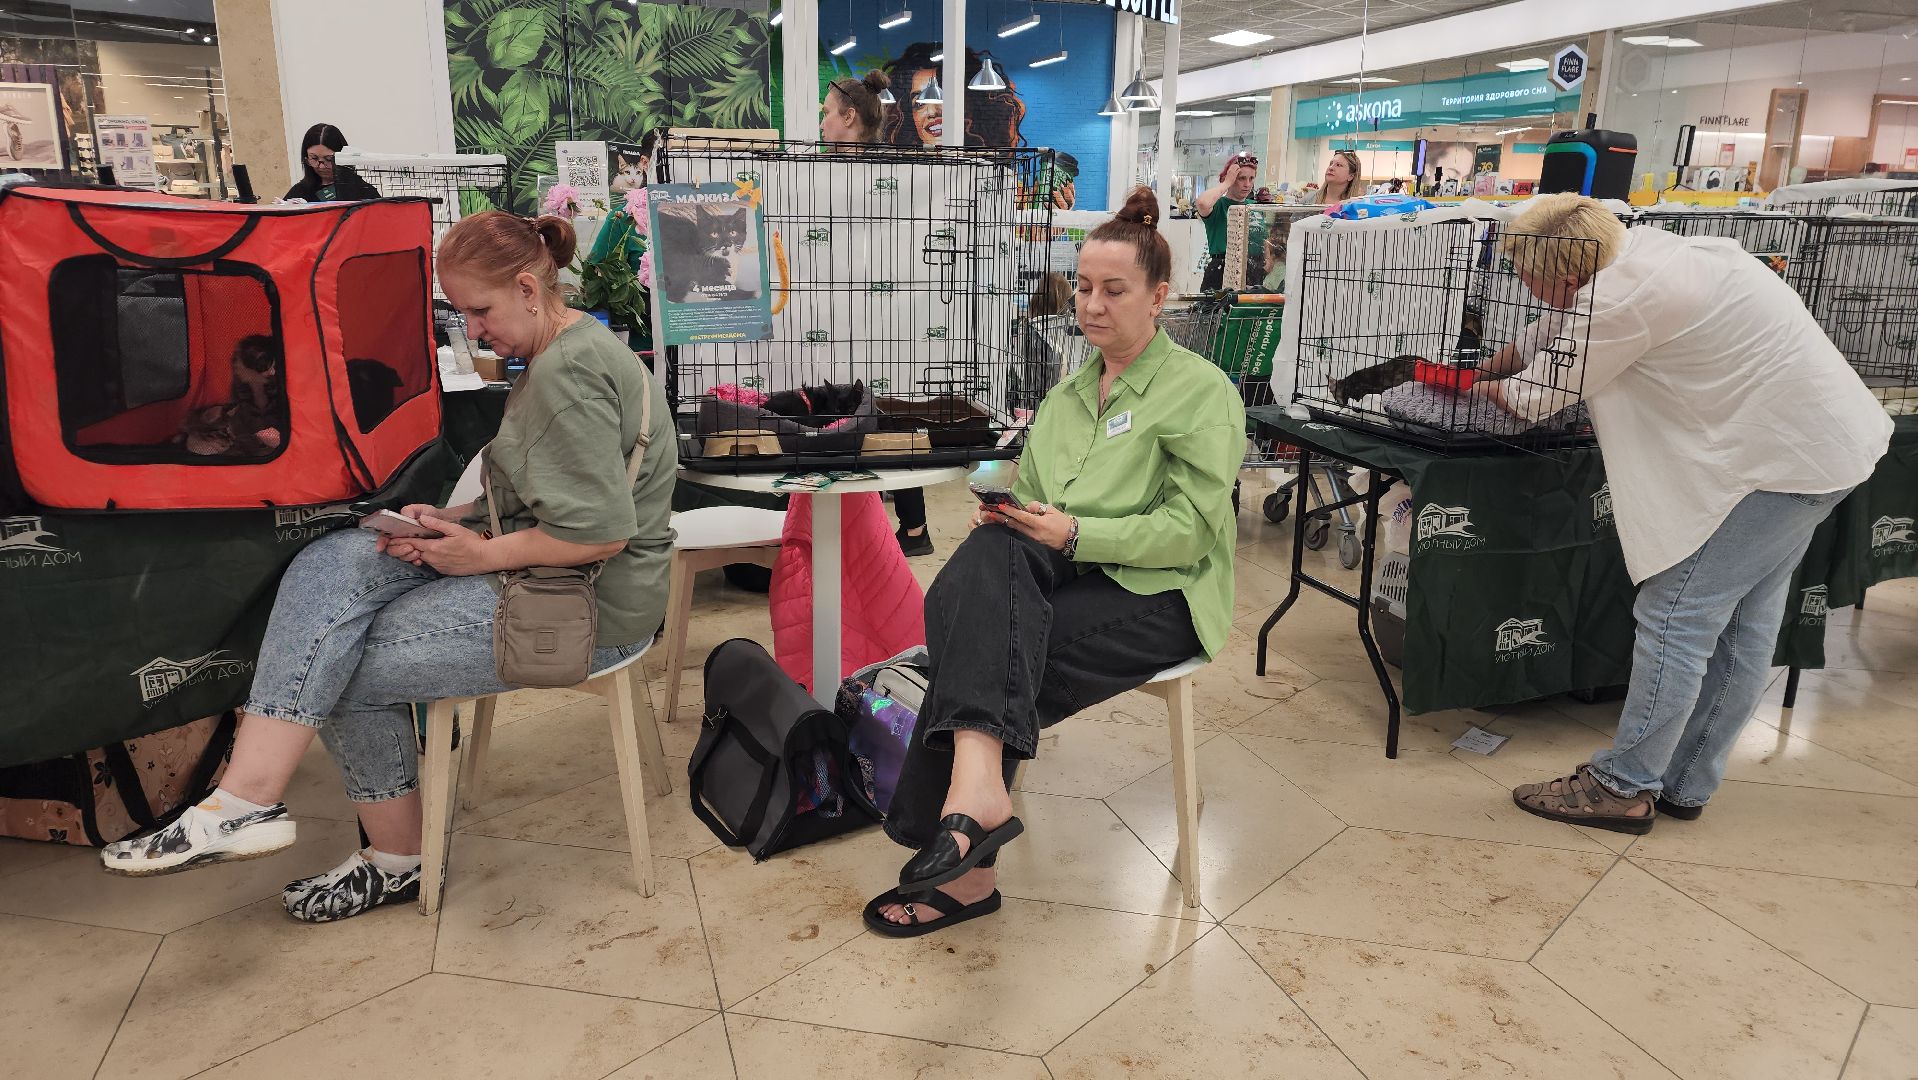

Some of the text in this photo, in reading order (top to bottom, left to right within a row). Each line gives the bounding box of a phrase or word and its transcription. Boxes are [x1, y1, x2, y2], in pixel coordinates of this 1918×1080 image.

[1563, 57, 1579, 65] FINN
[1561, 65, 1580, 73] FLARE
[1345, 98, 1402, 122] askona
[1700, 115, 1750, 126] FINN FLARE
[675, 192, 740, 204] МАРКИЗА
[692, 284, 700, 293] 4
[1464, 537, 1486, 550] ДОМ
[41, 551, 82, 567] ДОМ
[1534, 643, 1556, 657] ДОМ
[217, 660, 254, 681] ДОМ
